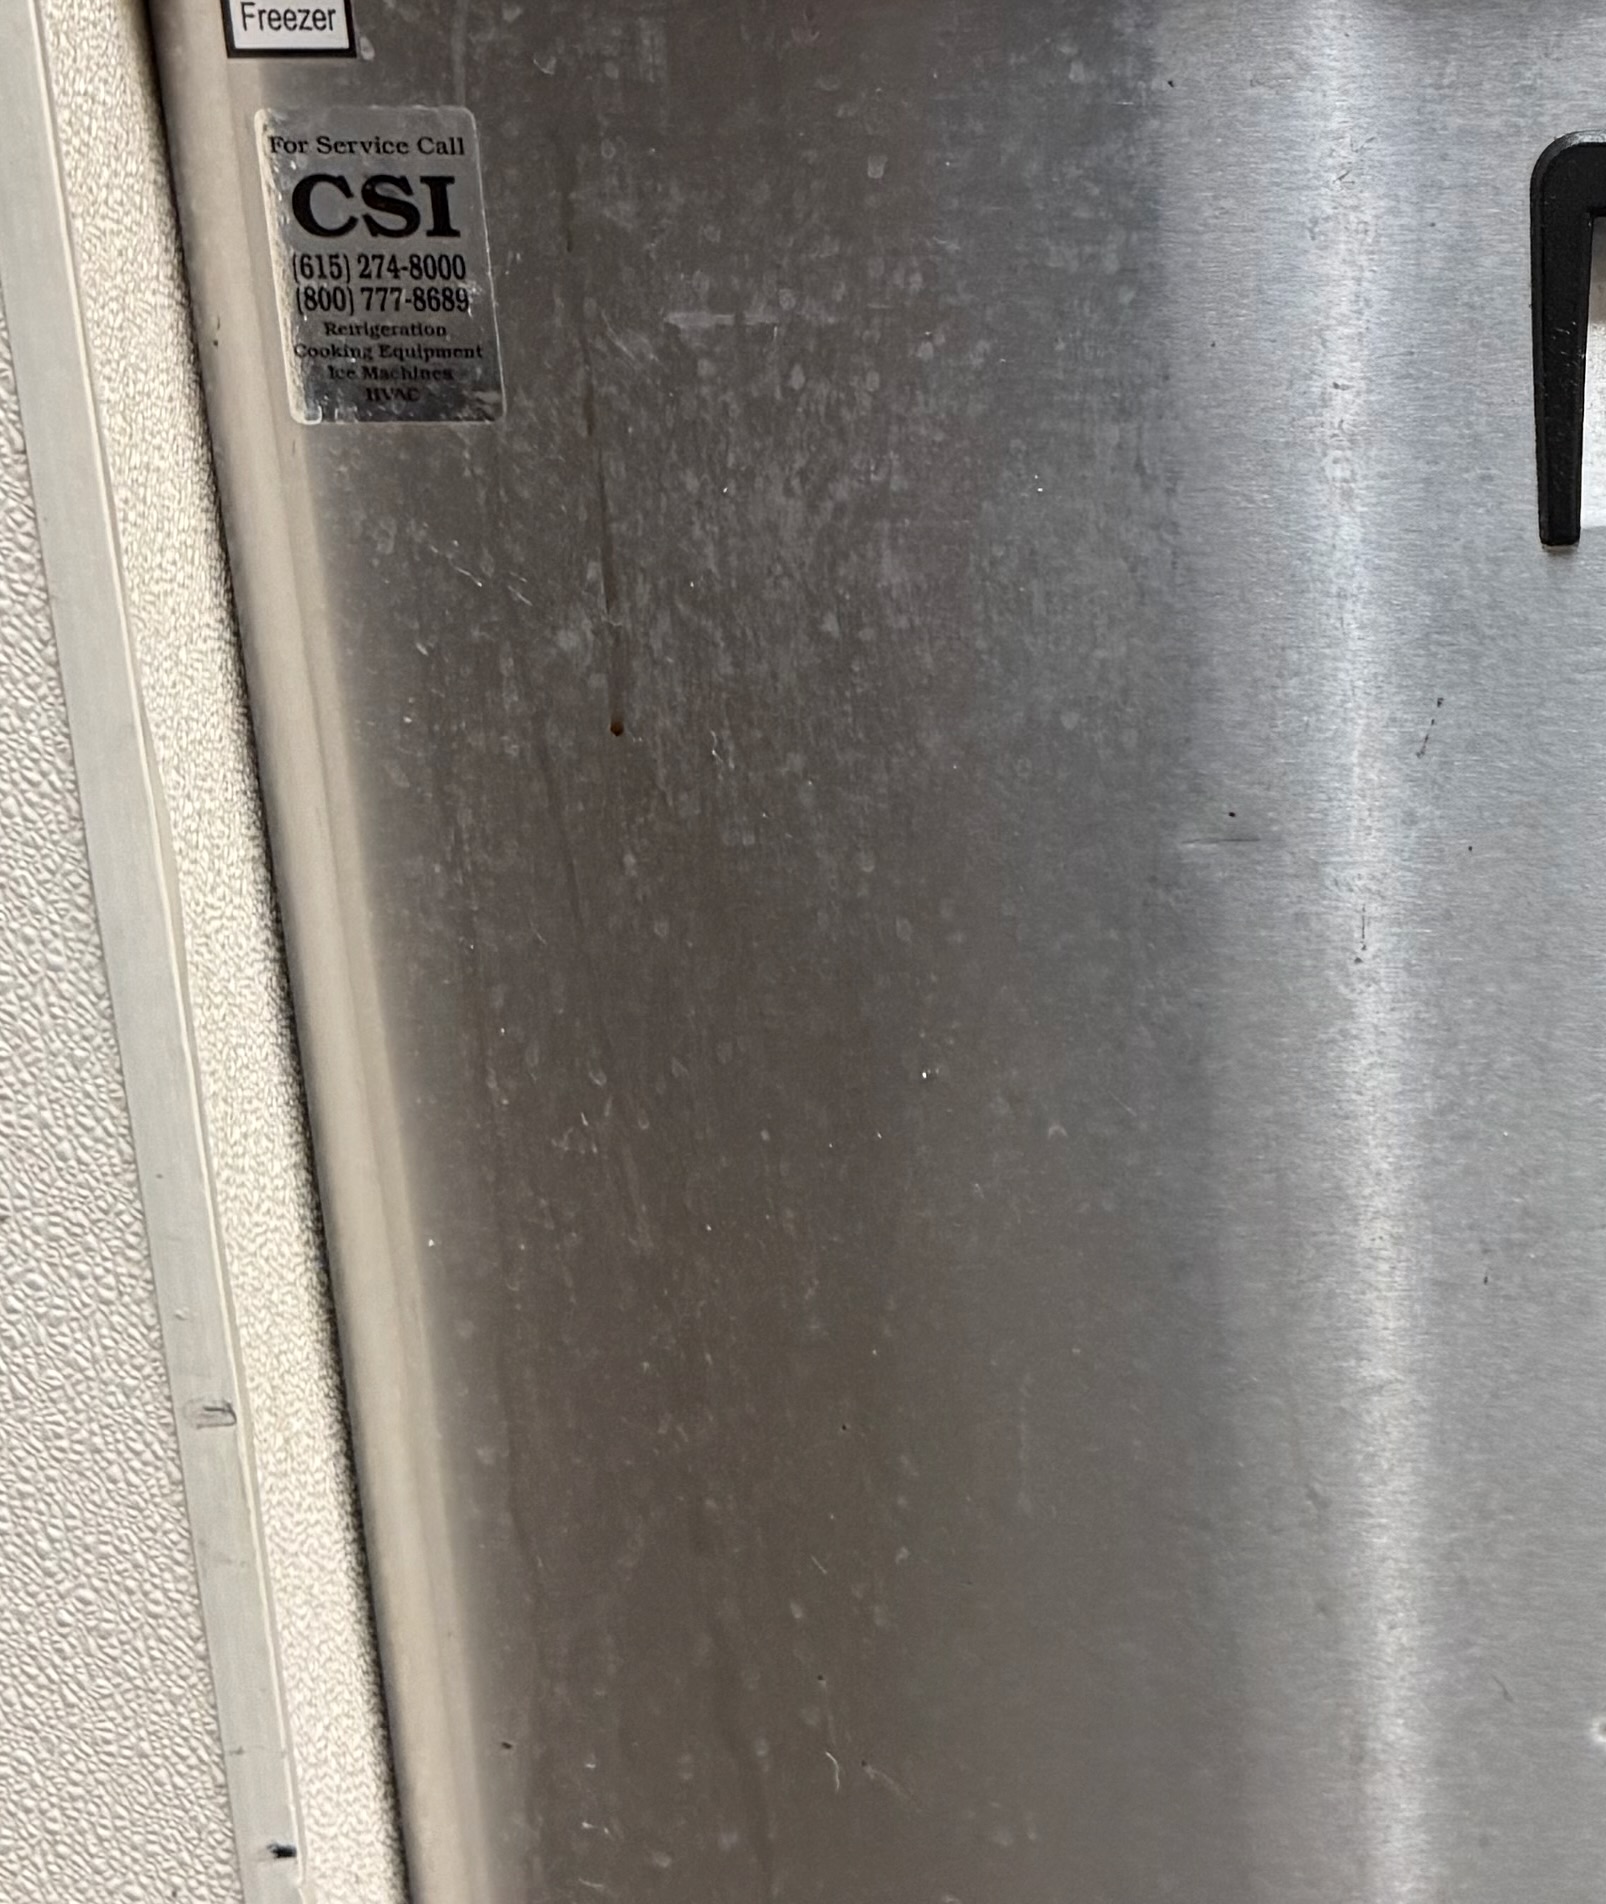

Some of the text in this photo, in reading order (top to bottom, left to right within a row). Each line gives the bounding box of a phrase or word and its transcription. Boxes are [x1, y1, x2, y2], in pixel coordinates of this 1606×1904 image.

[241, 1, 336, 32] Freezer
[270, 135, 465, 156] For Service Call
[291, 173, 461, 238] CSI
[292, 253, 466, 283] (615) 274-8000
[296, 286, 470, 316] (800) 777-8689
[324, 321, 447, 339] Refrigeration
[294, 344, 483, 362] Cooking Equipment
[328, 365, 454, 381] Ice Machines
[366, 387, 420, 402] HVAC
